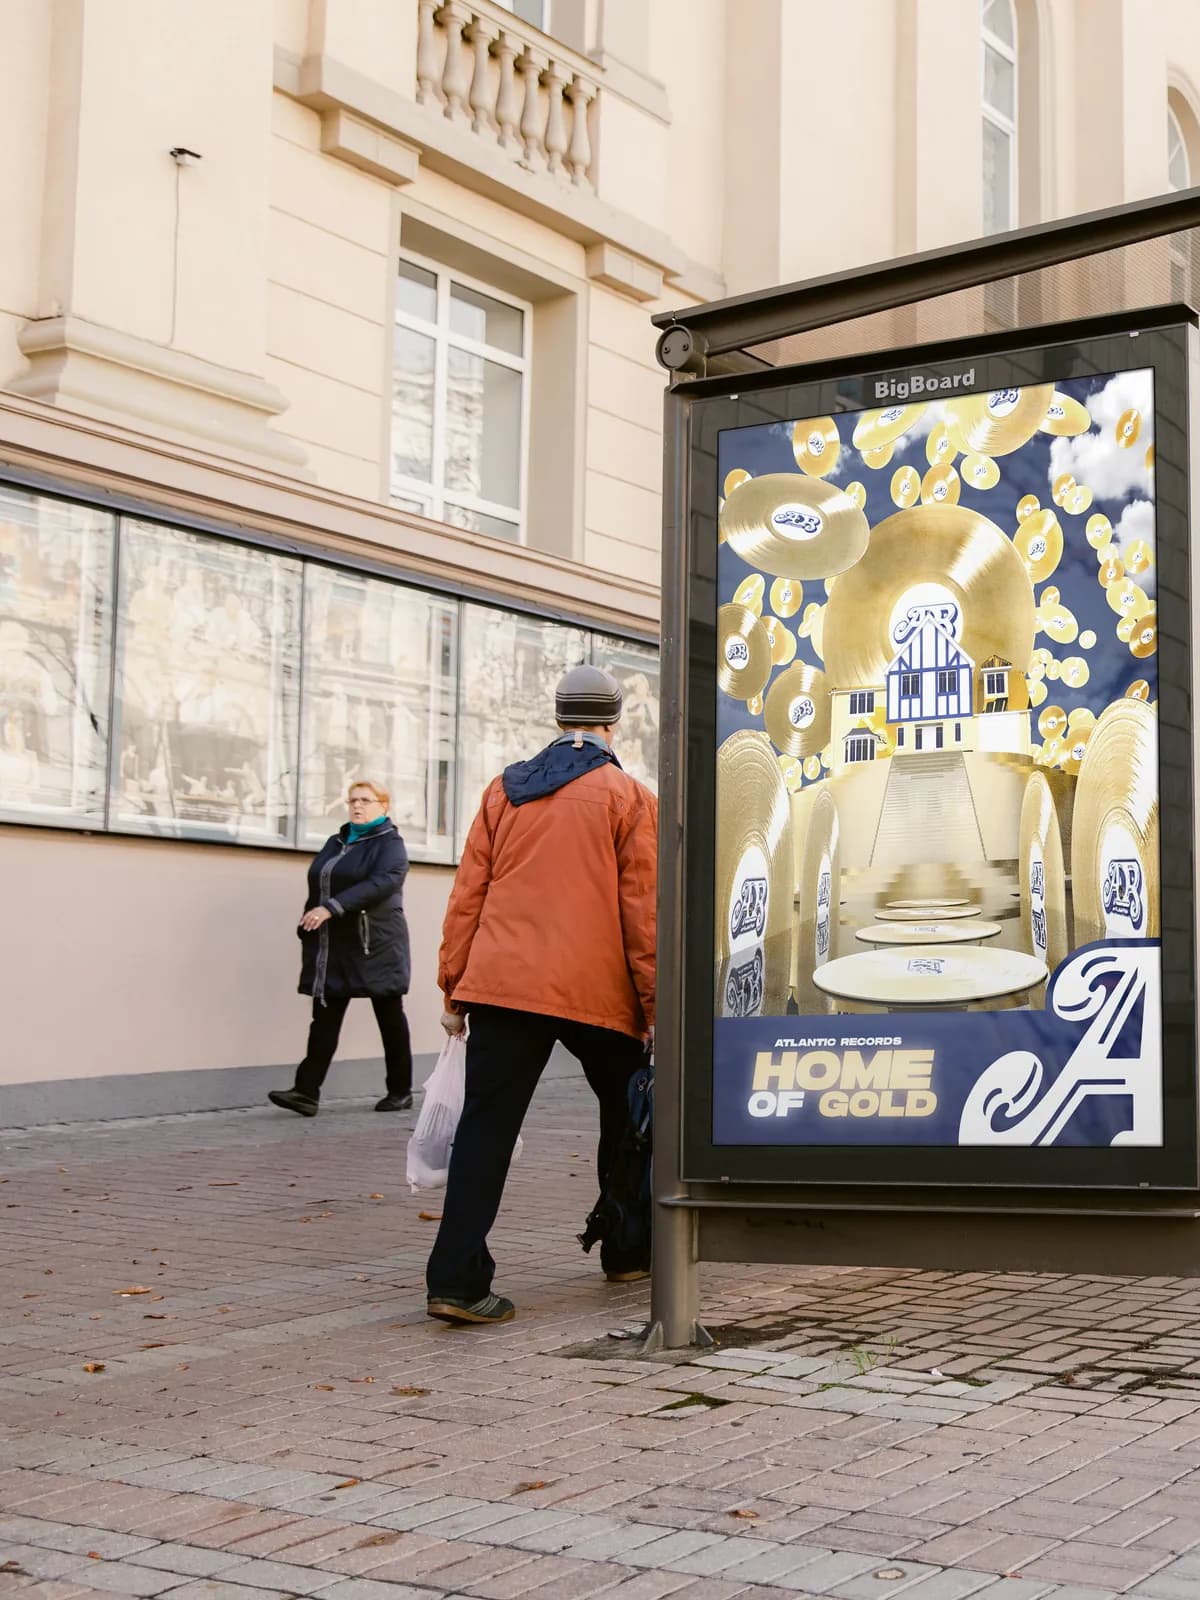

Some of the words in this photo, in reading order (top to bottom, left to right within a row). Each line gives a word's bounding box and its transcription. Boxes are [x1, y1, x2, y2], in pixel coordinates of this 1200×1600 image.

[874, 368, 975, 399] BigBoard
[774, 1038, 836, 1048] ATLANTIC
[840, 1036, 902, 1047] RECORDS
[752, 1050, 935, 1091] HOME
[747, 1091, 805, 1118] OF
[818, 1091, 938, 1118] GOLD
